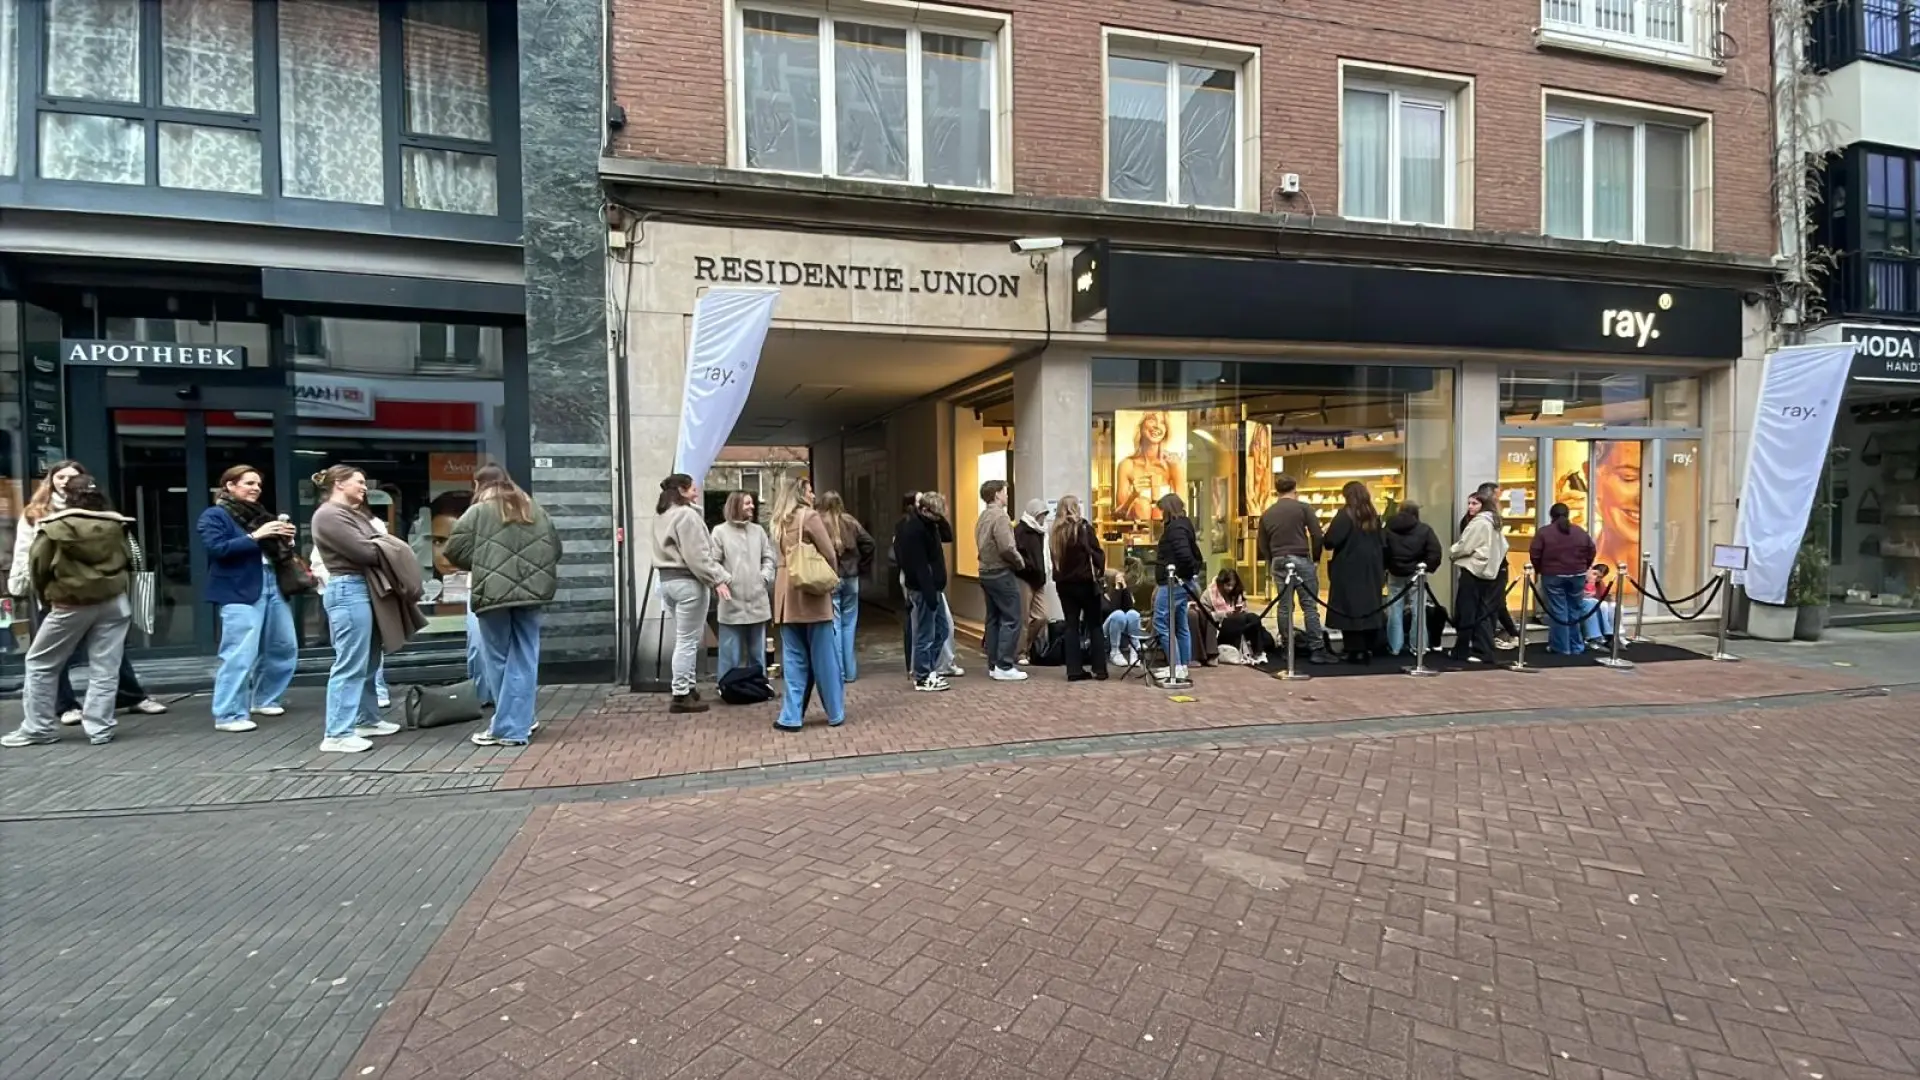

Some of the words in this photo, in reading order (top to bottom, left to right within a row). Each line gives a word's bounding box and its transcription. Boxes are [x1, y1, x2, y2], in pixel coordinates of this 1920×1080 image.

[1602, 308, 1660, 348] ray.
[68, 343, 235, 366] APOTHEEK
[1850, 334, 1915, 359] MODA
[704, 366, 735, 387] ray.
[1781, 405, 1817, 421] ray.
